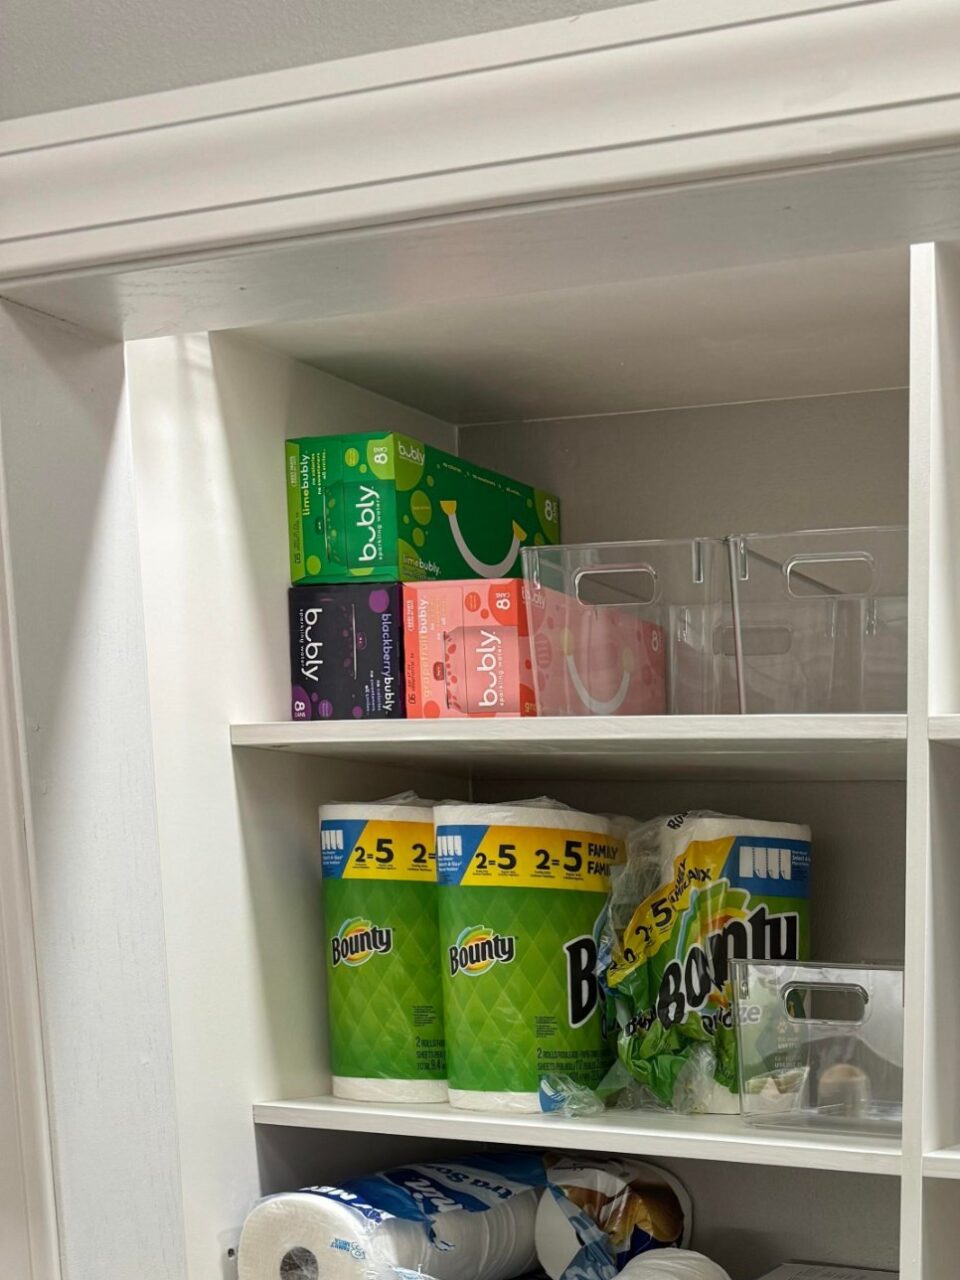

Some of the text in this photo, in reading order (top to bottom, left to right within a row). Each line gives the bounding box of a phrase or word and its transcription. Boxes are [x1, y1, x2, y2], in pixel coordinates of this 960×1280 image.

[374, 453, 388, 465] 8
[398, 440, 425, 466] bubly
[300, 453, 311, 517] limebubly
[356, 485, 380, 561] bubly
[402, 553, 441, 576] limebubly
[496, 598, 510, 610] 8
[301, 607, 323, 681] bubly
[381, 613, 395, 711] blackberrybubly
[476, 630, 501, 707] bubly
[294, 700, 306, 711] 8
[354, 838, 394, 864] 2=5
[411, 843, 437, 864] 2=
[475, 844, 517, 870] 2=5
[535, 840, 583, 872] 2=5
[331, 926, 392, 966] Bounty
[449, 934, 515, 976] Bounty
[657, 904, 799, 1030] Bounty
